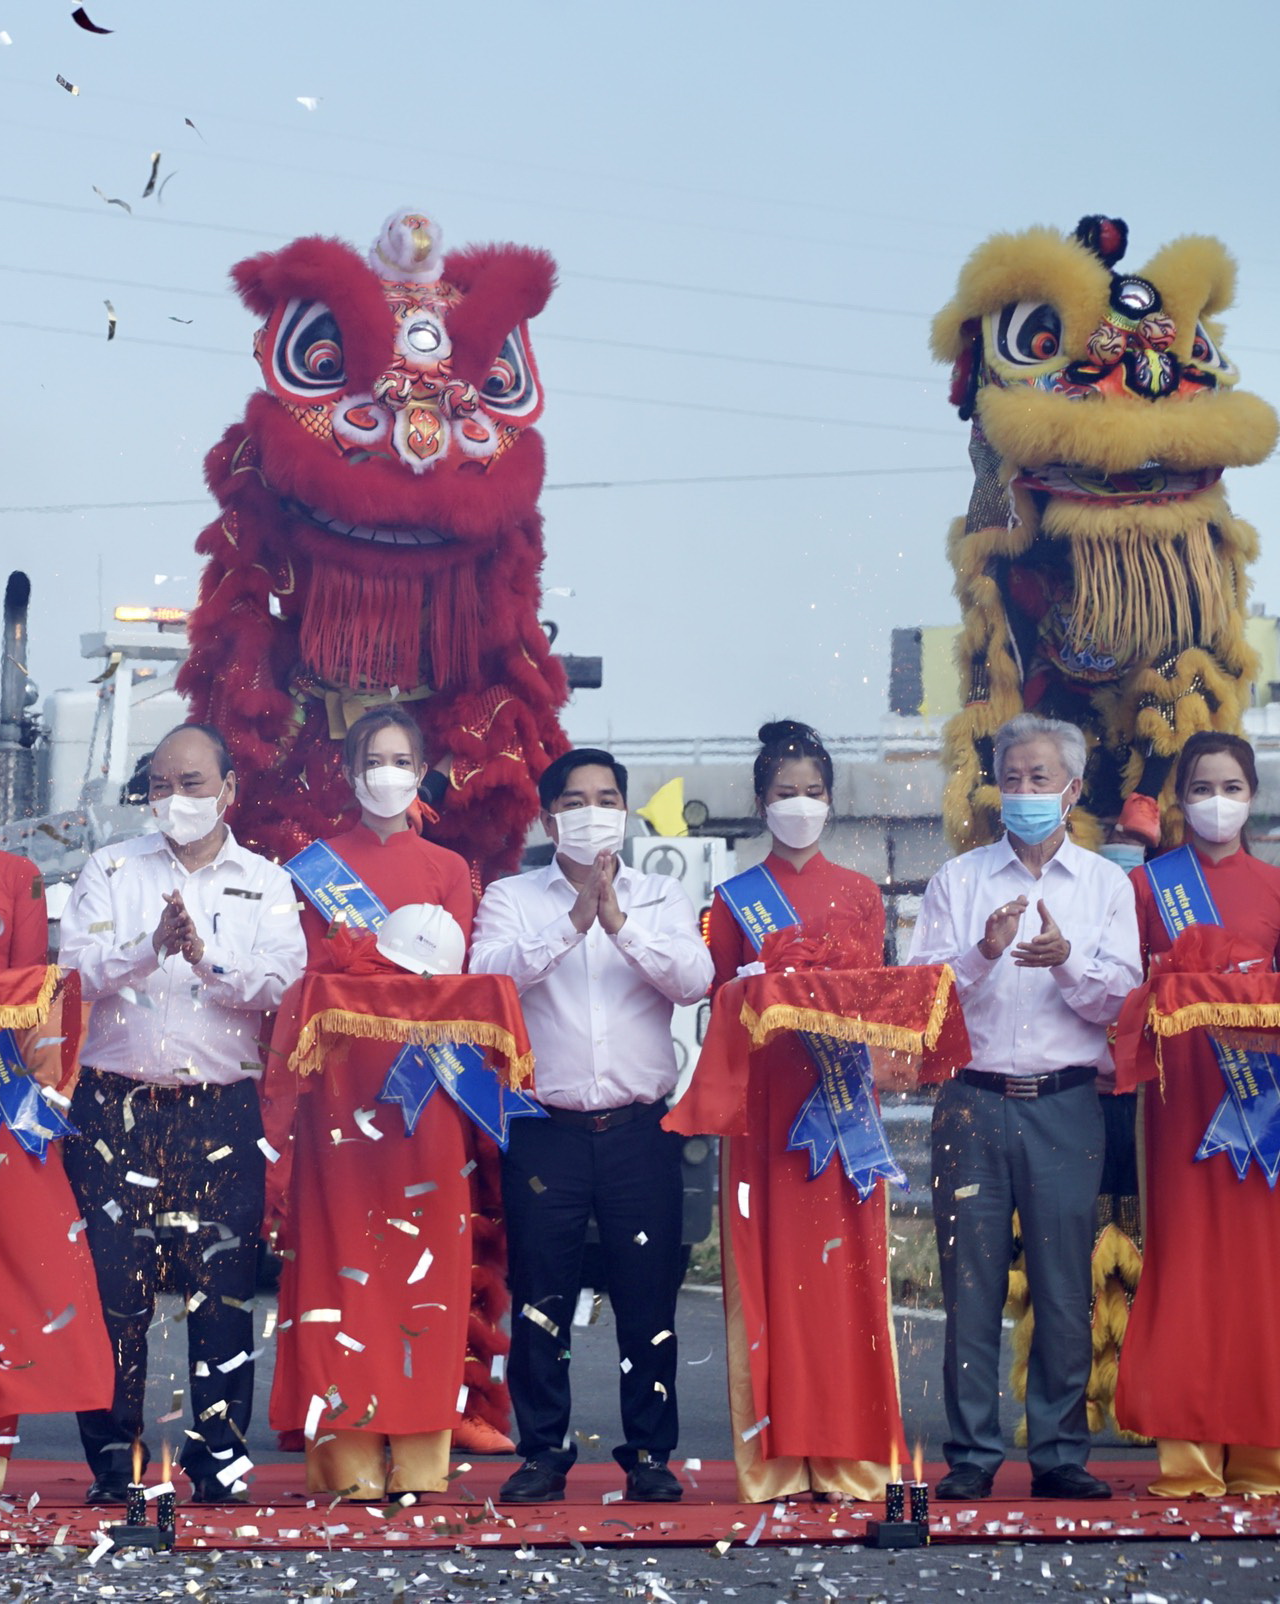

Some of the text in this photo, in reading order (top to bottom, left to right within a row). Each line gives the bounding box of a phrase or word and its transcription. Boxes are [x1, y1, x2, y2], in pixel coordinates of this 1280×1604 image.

[439, 1063, 454, 1081] 2022
[1235, 1080, 1248, 1099] 2022
[831, 1094, 842, 1114] 2022
